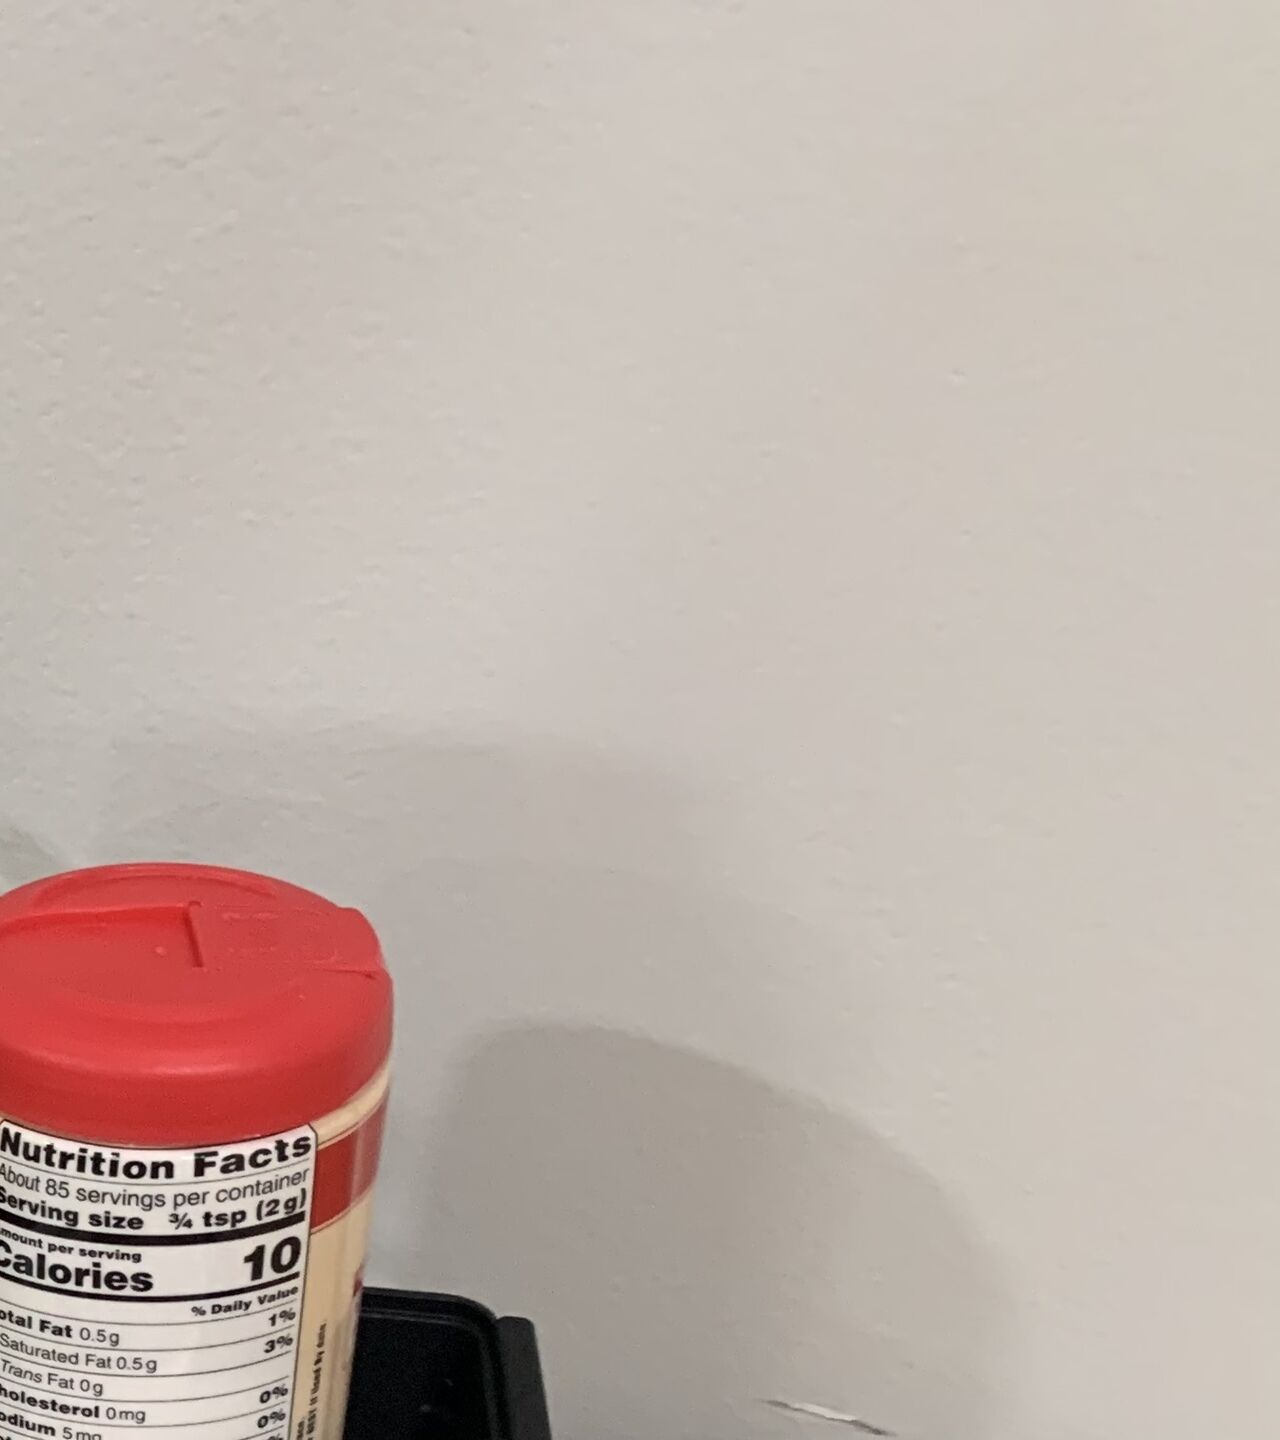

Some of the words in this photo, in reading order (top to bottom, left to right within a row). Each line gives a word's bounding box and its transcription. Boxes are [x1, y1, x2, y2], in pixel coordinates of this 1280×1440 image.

[0, 1128, 174, 1179] Nutrition
[194, 1134, 311, 1177] Facts
[44, 1180, 70, 1199] 85
[75, 1186, 166, 1209] servings
[172, 1190, 208, 1209] per
[215, 1168, 309, 1203] container
[88, 1213, 144, 1230] size
[202, 1208, 246, 1230] tsp
[48, 1243, 74, 1257] per
[79, 1249, 142, 1263] serving
[244, 1236, 302, 1281] 10
[210, 1299, 251, 1315] Daily
[257, 1286, 298, 1306] Value
[39, 1320, 72, 1338] Fat
[269, 1308, 296, 1327] 1%
[0, 1334, 80, 1366] Saturated
[85, 1351, 112, 1368] Fat
[264, 1334, 293, 1353] 3%
[1, 1359, 42, 1384] Trans
[48, 1373, 74, 1391] Fat
[259, 1384, 288, 1405] 0%
[257, 1409, 286, 1430] 0%
